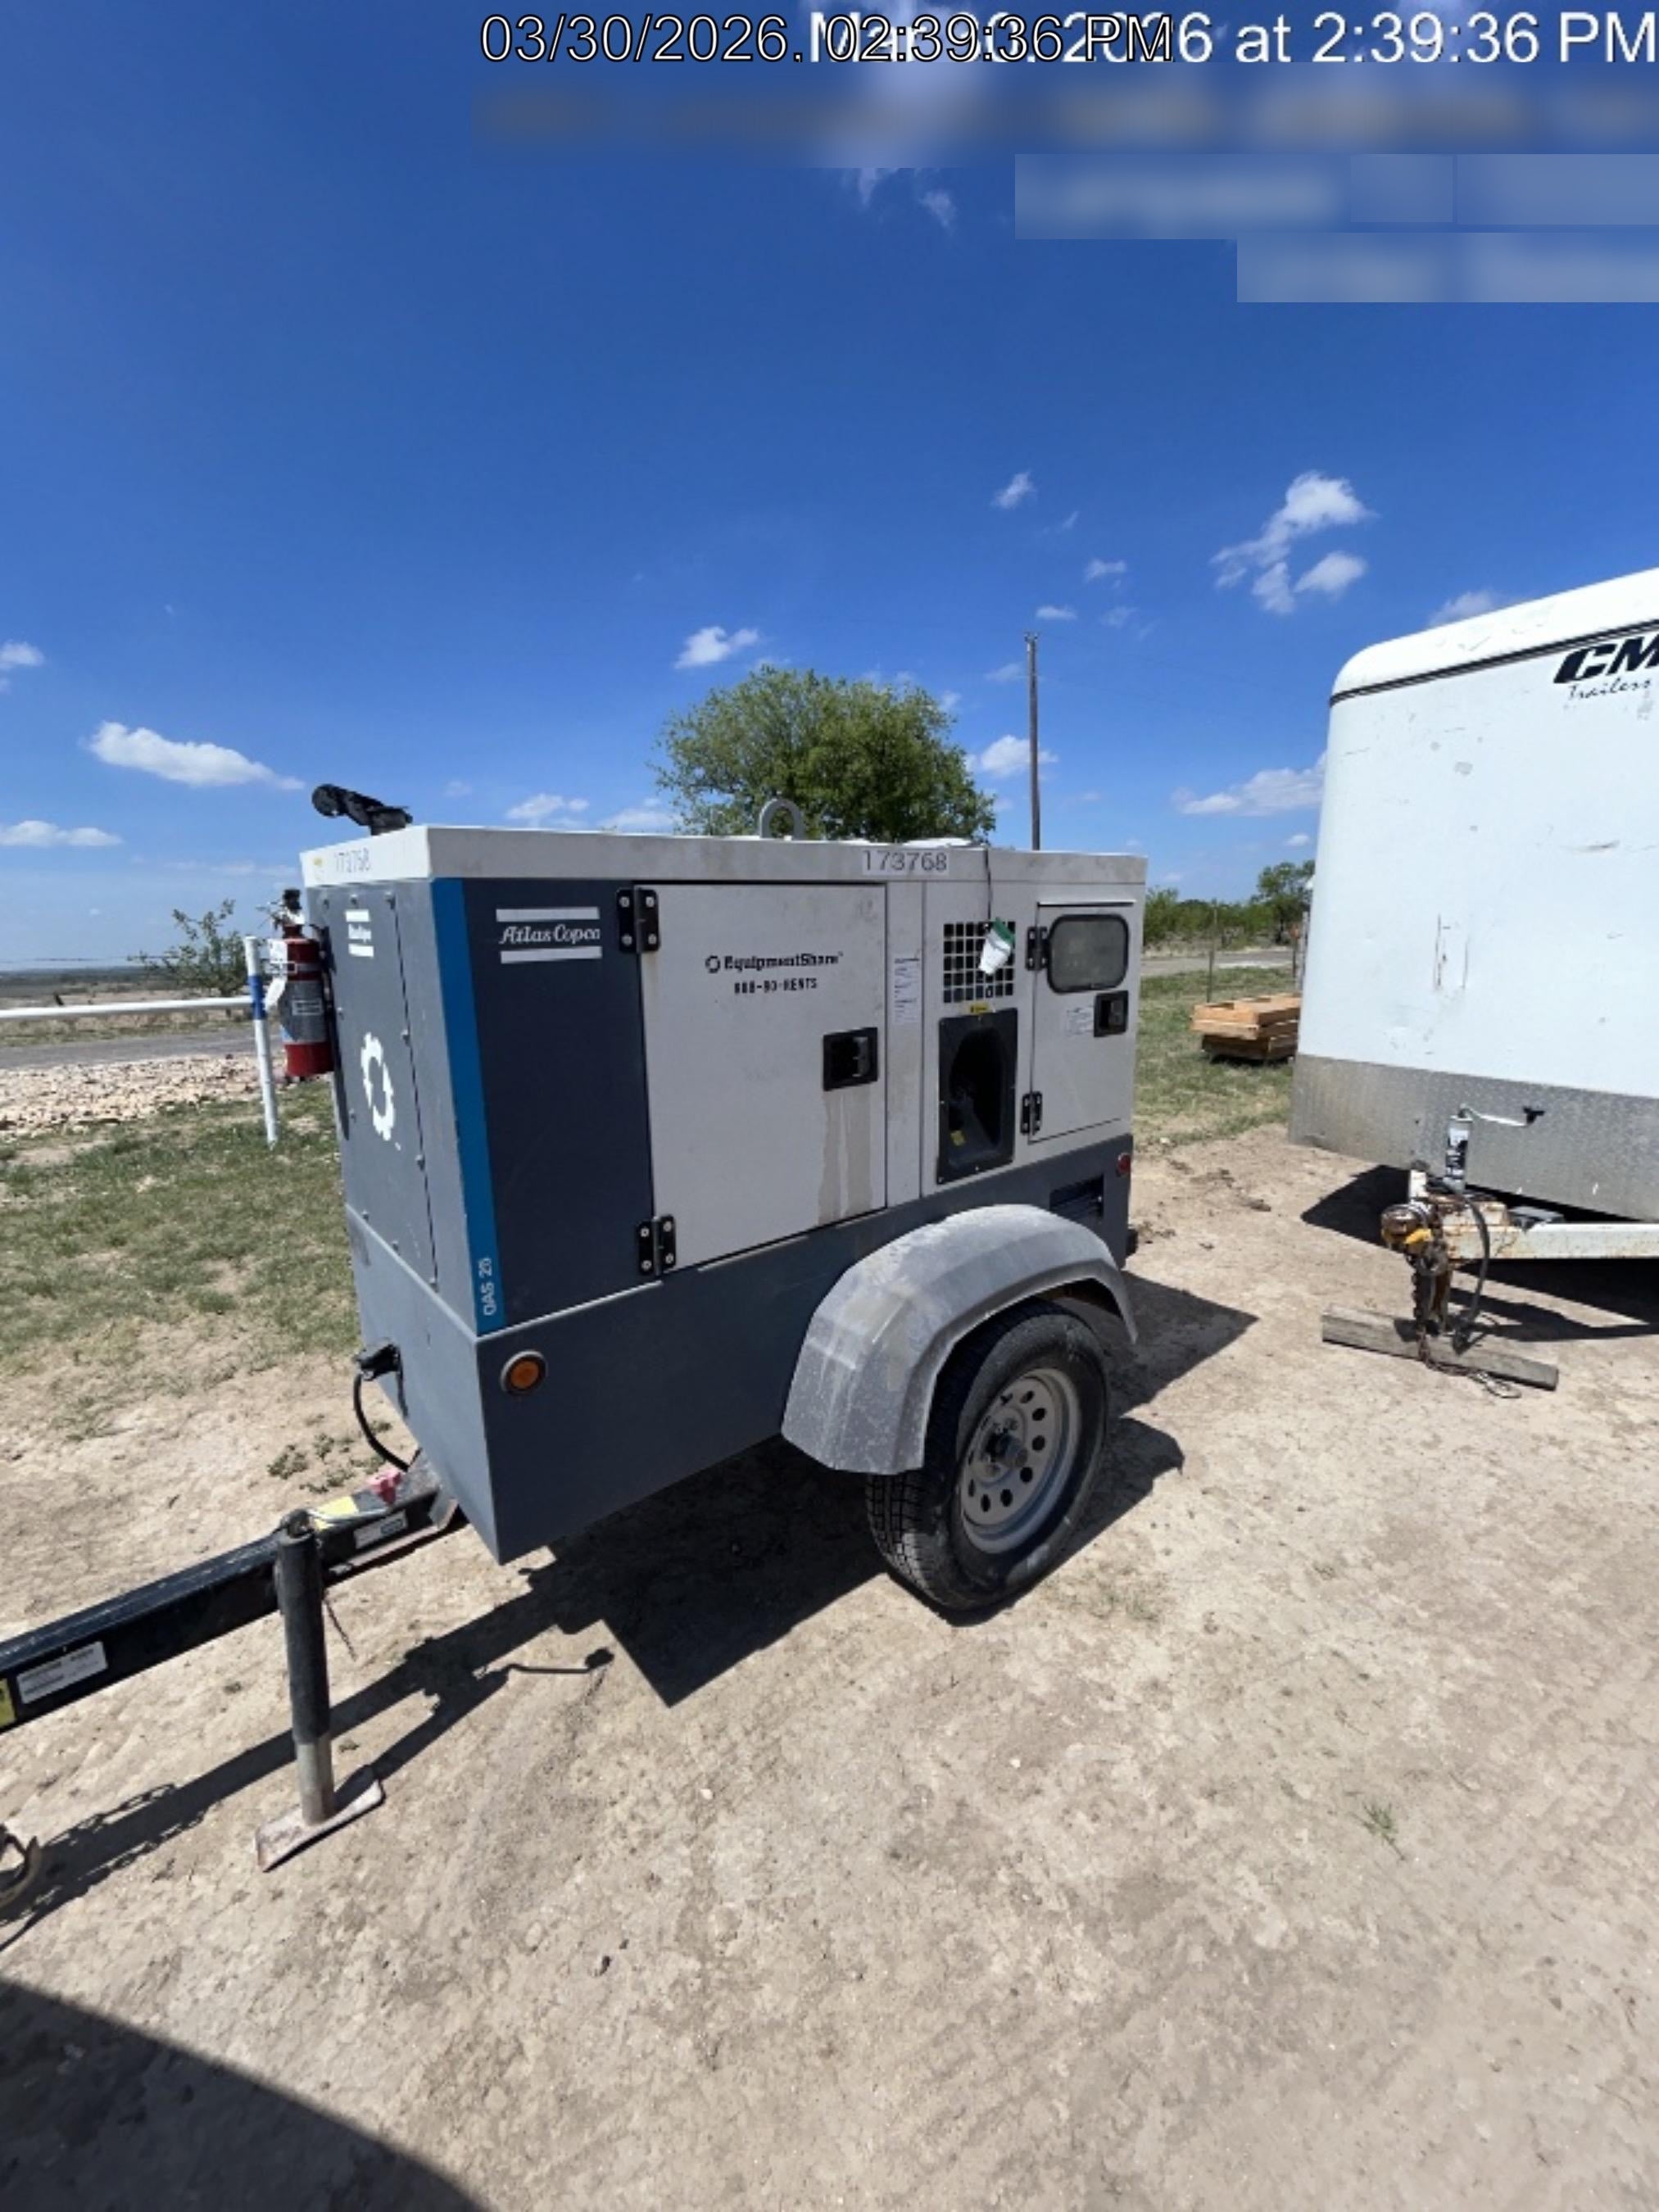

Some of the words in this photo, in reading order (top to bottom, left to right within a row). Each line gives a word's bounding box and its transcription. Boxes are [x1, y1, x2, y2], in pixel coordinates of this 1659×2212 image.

[863, 850, 948, 871] 173768
[498, 925, 551, 945] Atlas
[553, 923, 600, 945] Copco
